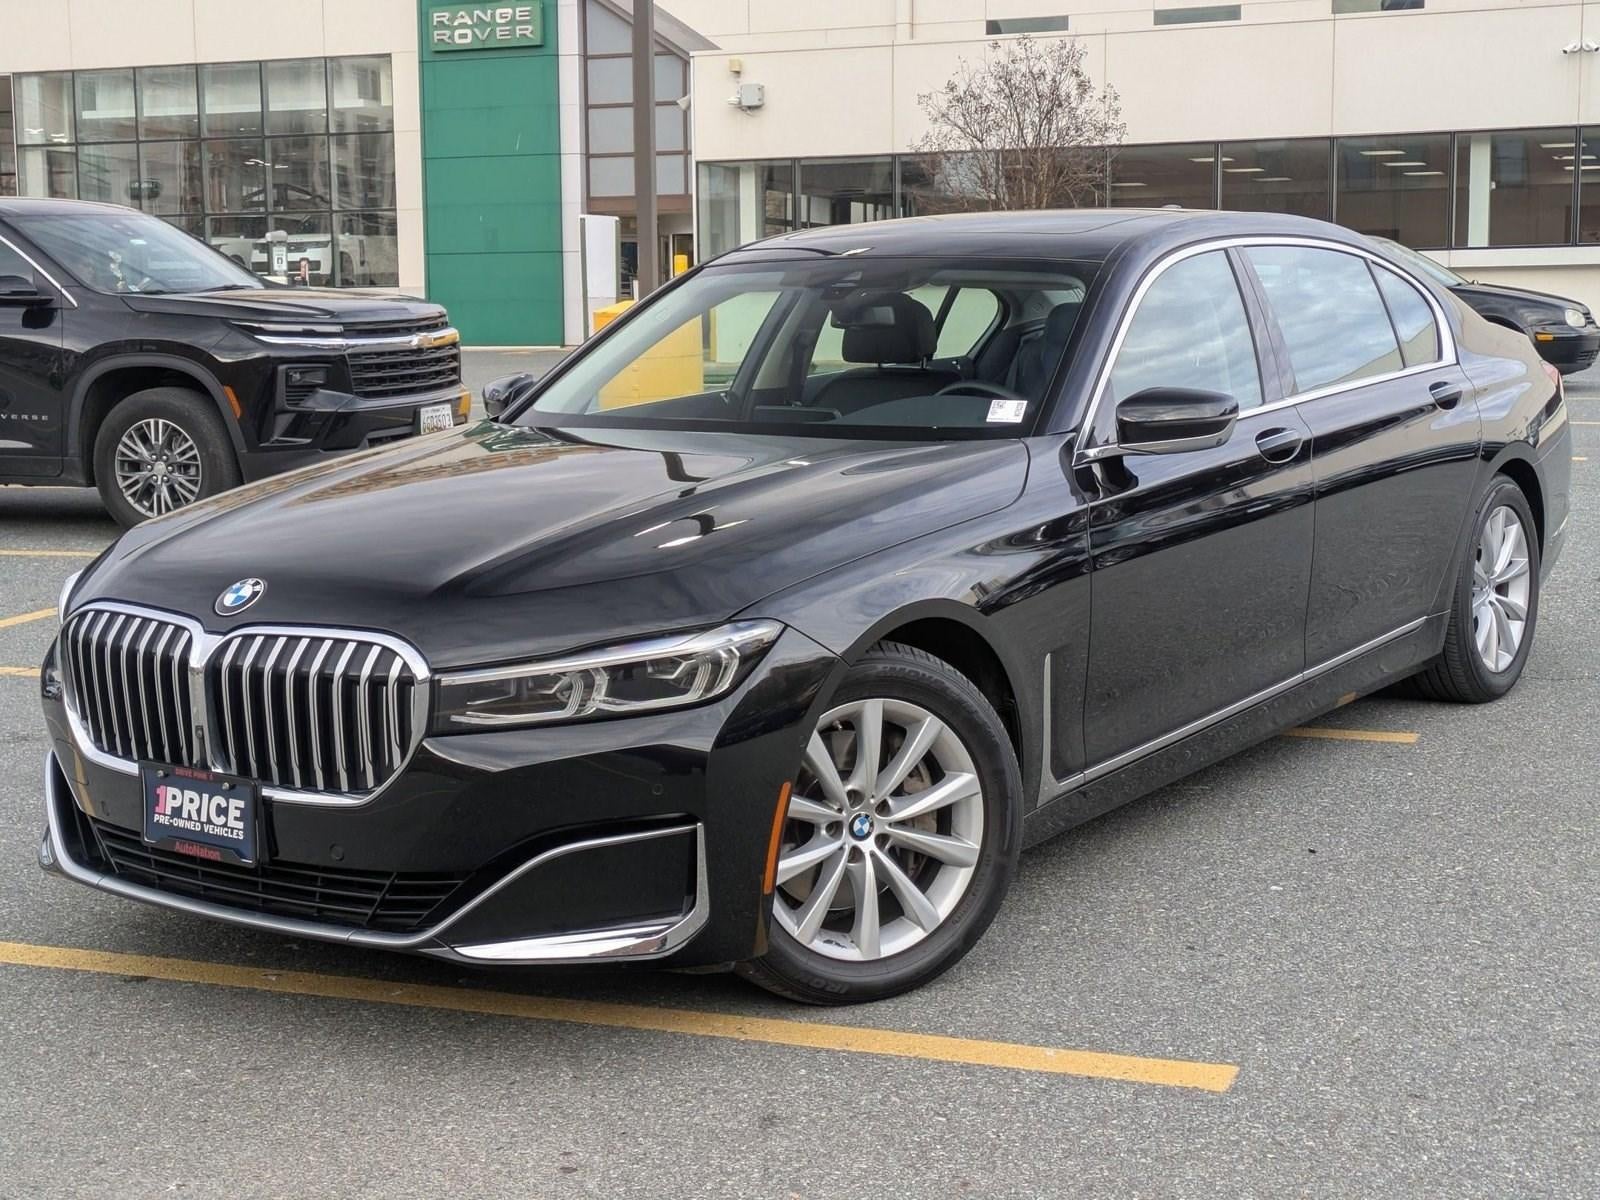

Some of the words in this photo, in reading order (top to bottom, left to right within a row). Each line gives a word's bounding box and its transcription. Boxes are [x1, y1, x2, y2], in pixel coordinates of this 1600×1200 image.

[433, 7, 533, 26] RANGE
[433, 25, 536, 44] ROVER
[154, 785, 245, 829] 1PRICE
[153, 814, 201, 832] PRE-OWNED
[203, 823, 244, 840] VEHICLES
[174, 841, 222, 861] AutoNation
